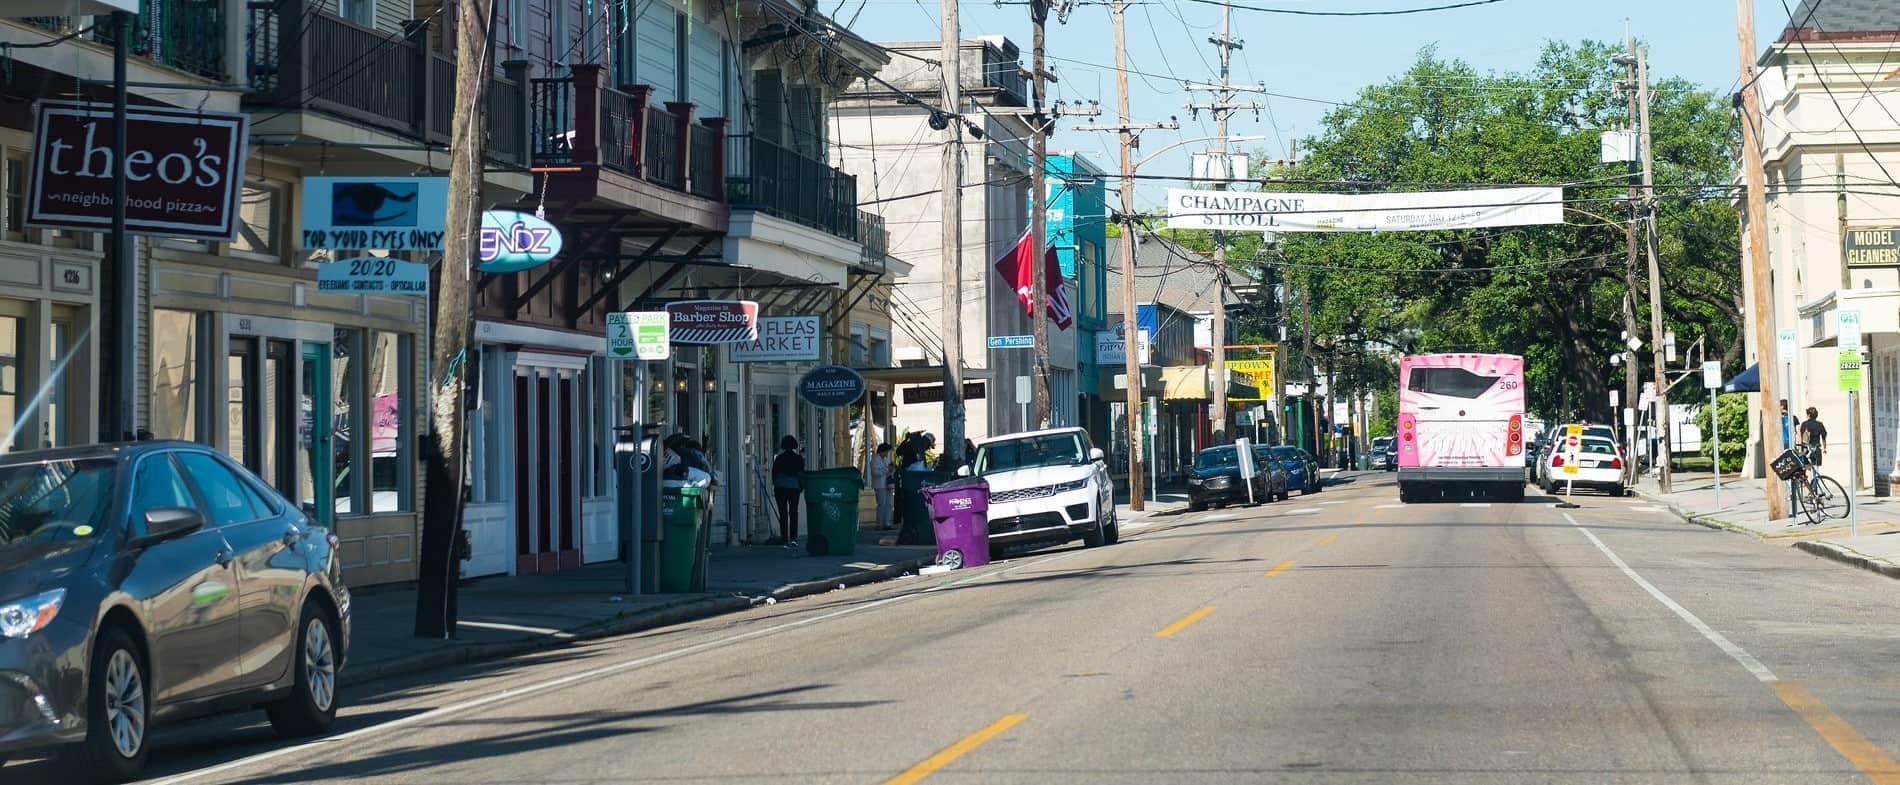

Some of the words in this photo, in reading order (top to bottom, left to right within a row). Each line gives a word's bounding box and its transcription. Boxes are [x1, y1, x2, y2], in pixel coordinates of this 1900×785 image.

[50, 121, 222, 187] theo's
[62, 191, 162, 210] neighbhood
[165, 199, 202, 213] pizza
[1180, 194, 1304, 212] CHAMPAGNE
[1203, 213, 1280, 227] STROLL
[303, 230, 327, 248] FOR
[329, 230, 368, 248] YOUR
[371, 229, 406, 249] EYES
[409, 229, 445, 248] ONLY
[1855, 231, 1895, 246] MODEL
[1849, 249, 1898, 264] CLEANERS
[350, 260, 396, 276] 20/20
[608, 314, 625, 324] PAY
[673, 311, 715, 323] Barber
[719, 311, 750, 325] Shop
[618, 325, 626, 338] 2
[766, 320, 816, 336] FLEAS
[611, 338, 634, 347] HOUR
[735, 336, 815, 352] MARKET
[807, 380, 856, 389] MAGAZINE
[1500, 381, 1518, 390] 260
